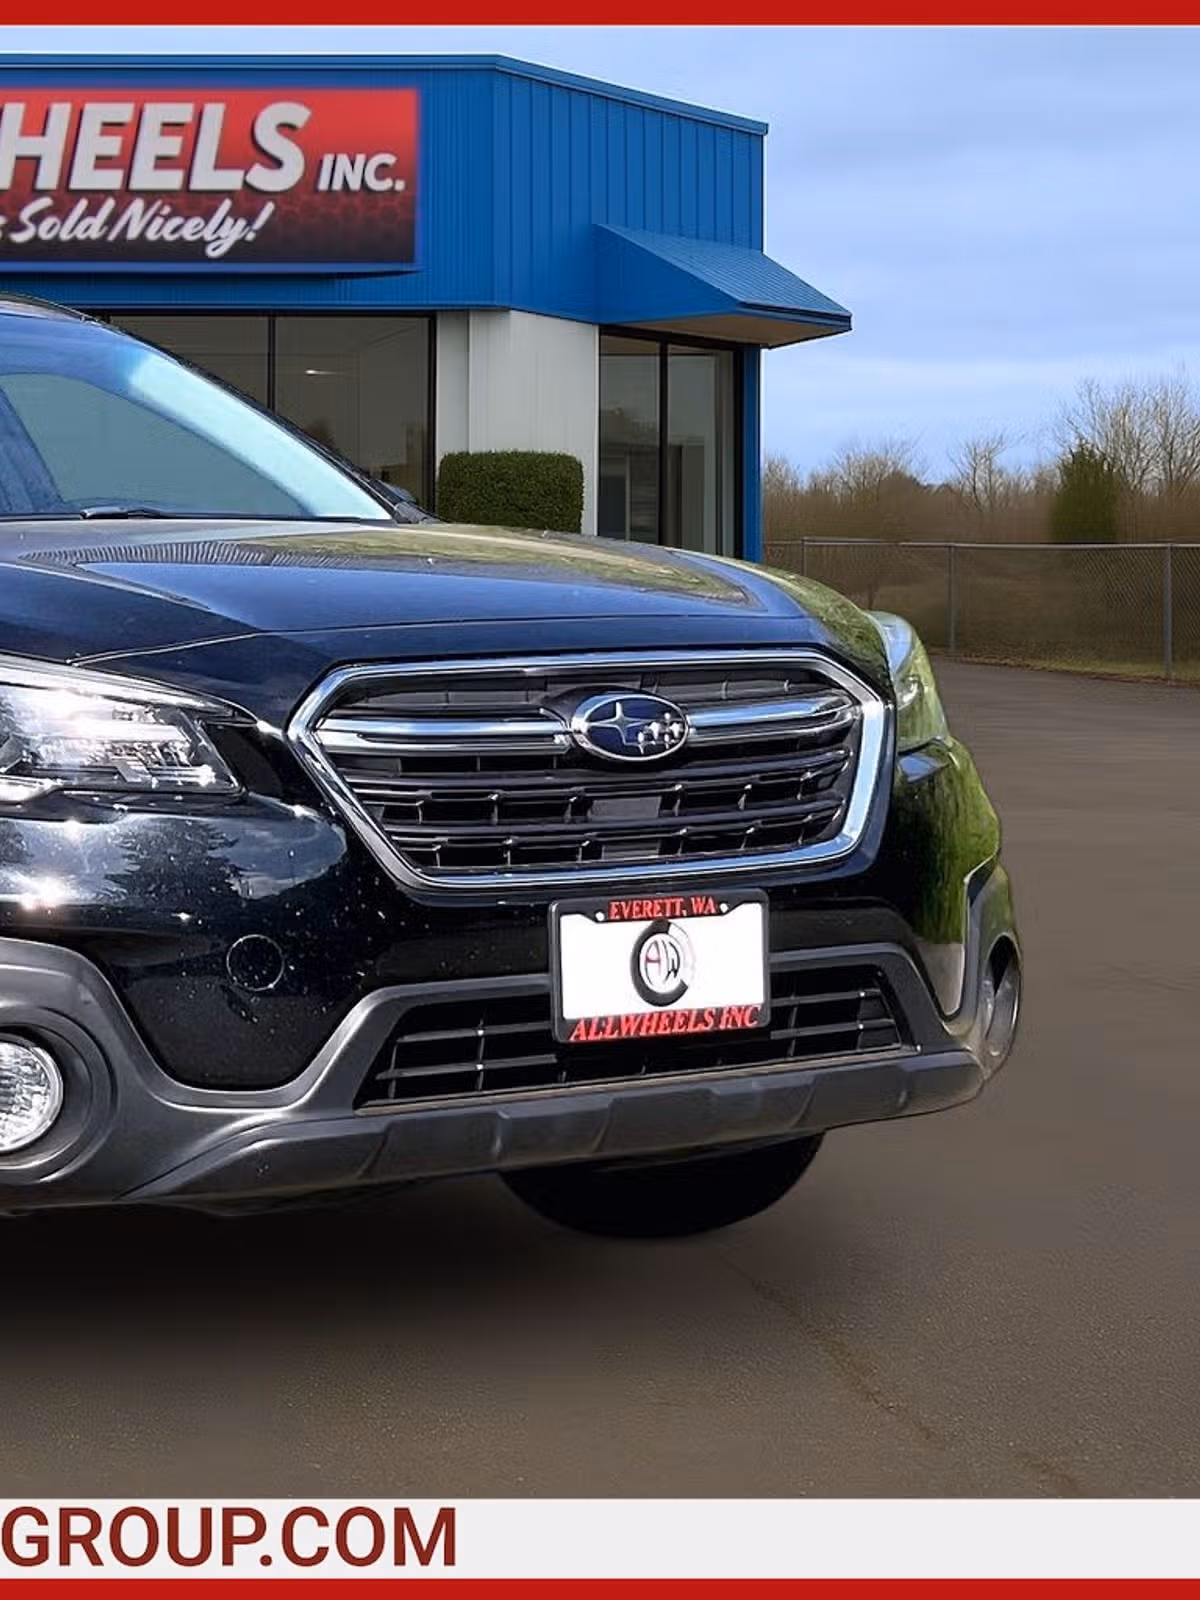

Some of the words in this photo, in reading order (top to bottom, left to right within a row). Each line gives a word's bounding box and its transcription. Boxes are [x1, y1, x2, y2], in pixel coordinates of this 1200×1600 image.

[318, 153, 406, 192] INC.
[8, 198, 108, 244] Sold
[108, 199, 277, 259] Nicely!
[608, 898, 688, 920] EVERETT,
[690, 896, 717, 915] WA
[568, 1011, 716, 1041] ALLWHEELS
[718, 1004, 763, 1029] INC
